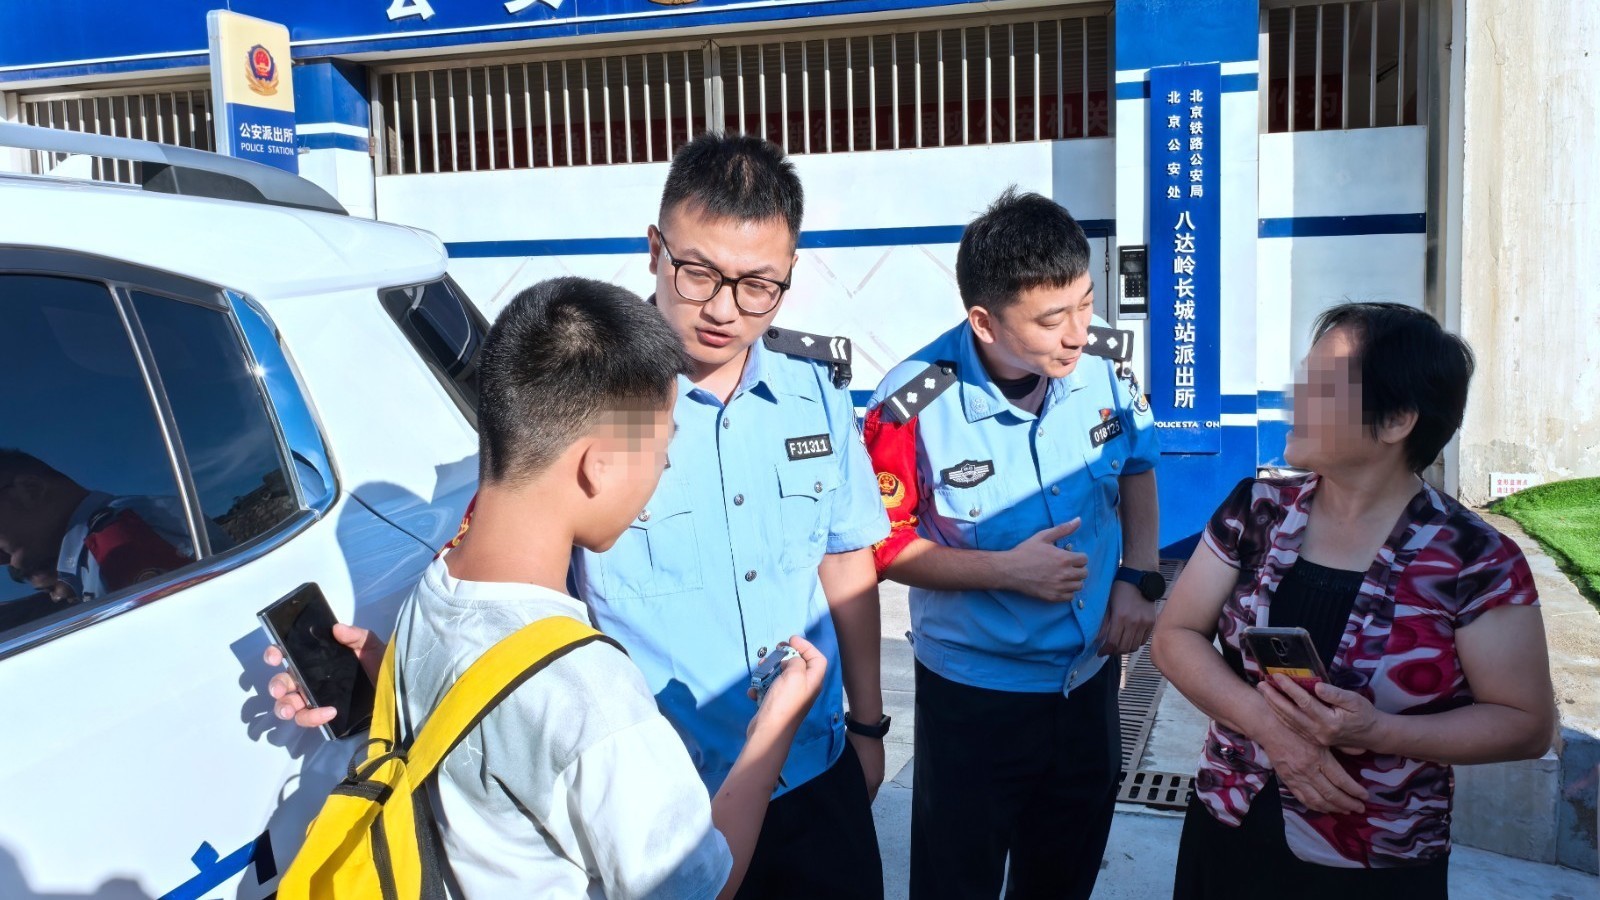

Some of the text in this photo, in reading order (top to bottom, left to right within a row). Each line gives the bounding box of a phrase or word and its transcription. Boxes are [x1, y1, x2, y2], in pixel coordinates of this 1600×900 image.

[239, 122, 293, 143] 公安派出所
[1189, 89, 1203, 198] 北京铁路公安局
[241, 142, 294, 155] POLICE STATION
[1167, 91, 1181, 199] 北京公安处
[1174, 210, 1196, 409] 八达岭长城站派出所
[1094, 420, 1120, 443] 018125
[789, 439, 828, 456] FJ1311
